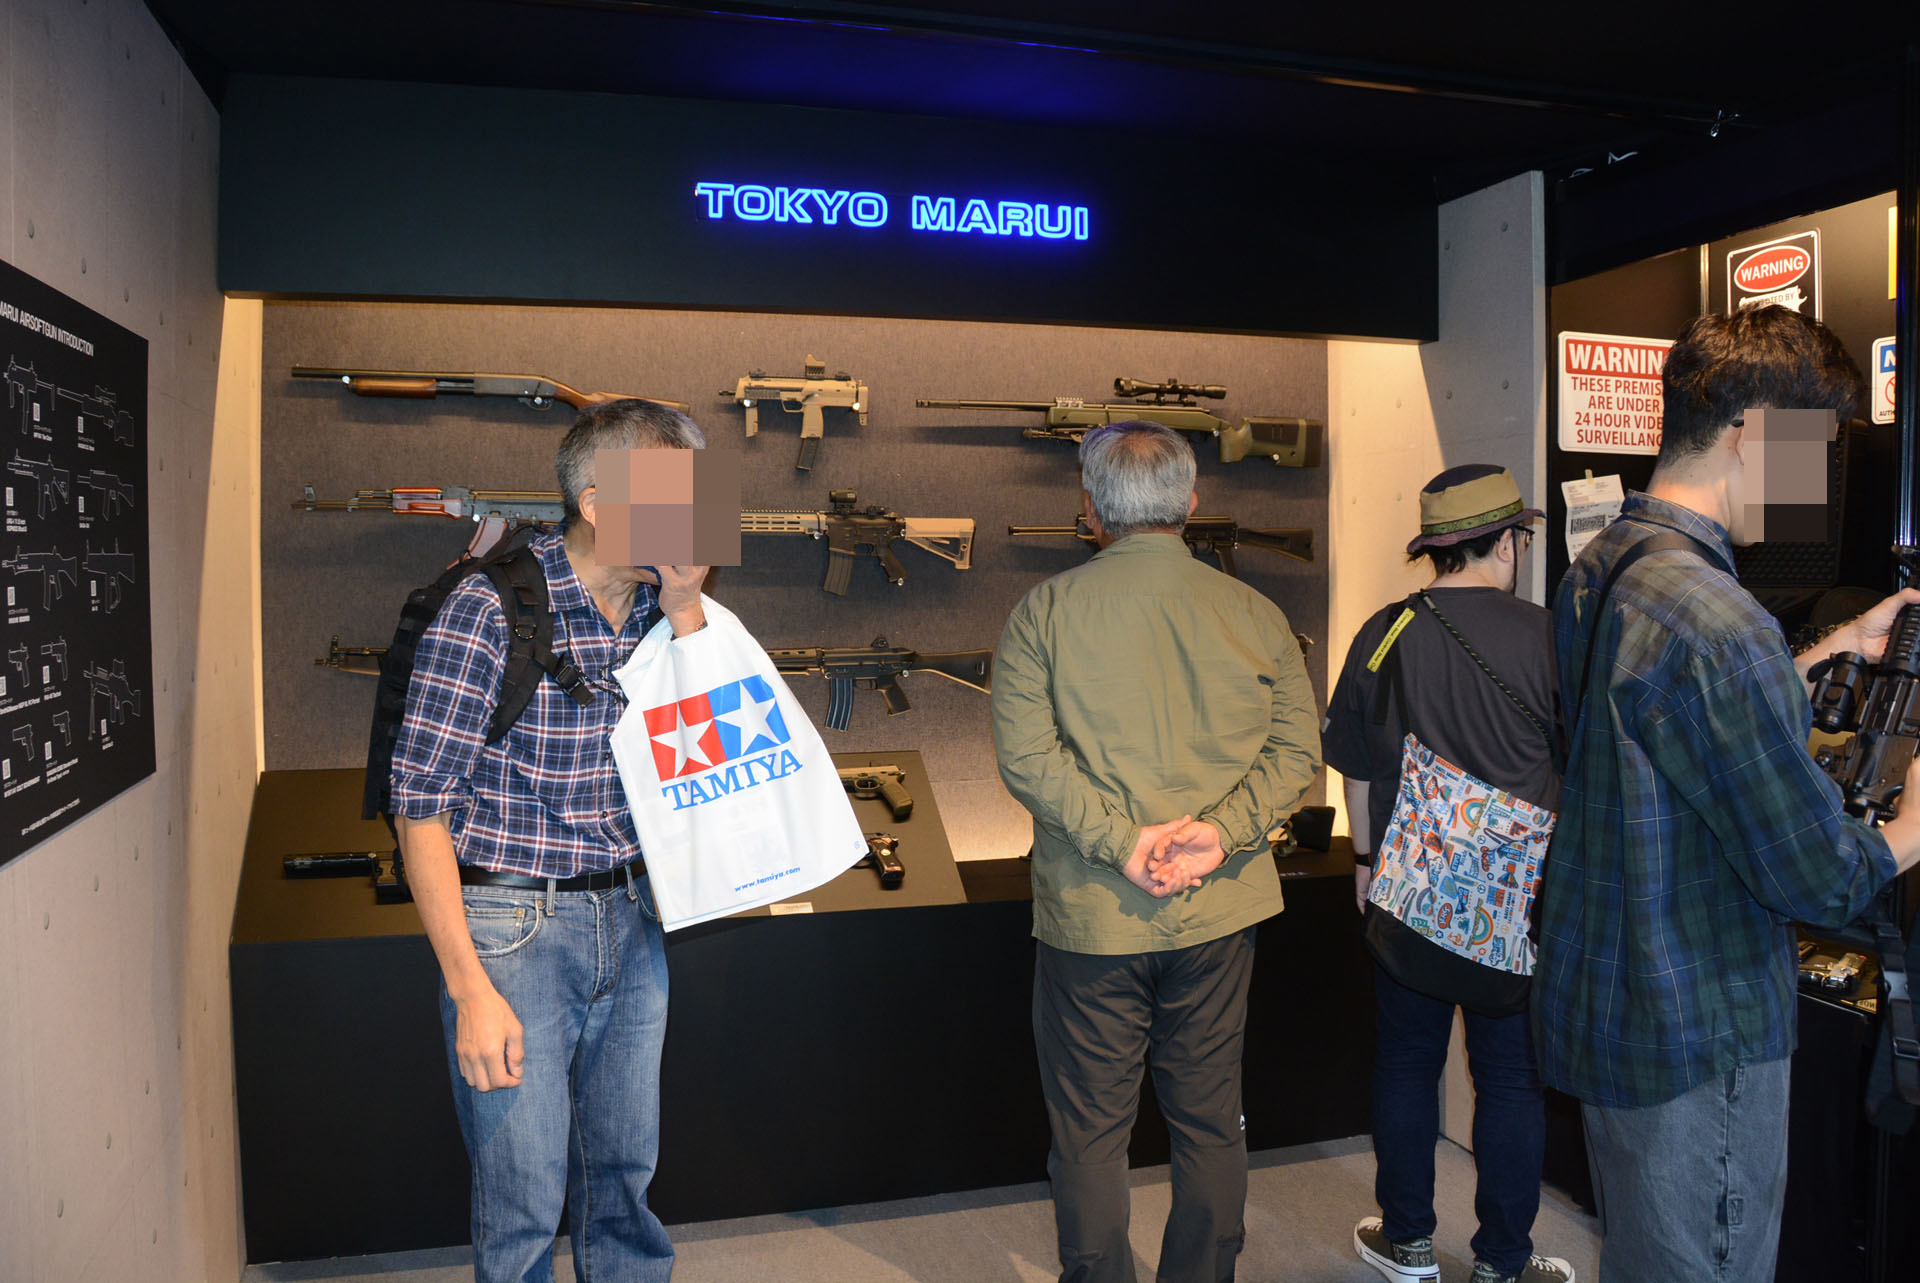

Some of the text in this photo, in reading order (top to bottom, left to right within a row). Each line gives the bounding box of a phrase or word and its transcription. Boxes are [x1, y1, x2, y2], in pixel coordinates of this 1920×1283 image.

[696, 182, 1089, 240] TOKYO MARUI
[1741, 256, 1804, 282] WARNING
[20, 311, 57, 340] AIRSOFTGUN
[58, 328, 94, 357] INTRODUCTION
[1569, 343, 1663, 375] WARNIN
[1571, 376, 1663, 396] THESE PREMIS
[1588, 395, 1660, 413] ARE UNDER
[1575, 411, 1663, 430] 24 HOUR VIDE
[1577, 429, 1662, 447] SURVEILLANC
[661, 749, 804, 811] TAMIYA
[734, 866, 802, 892] www.tamiya.com
[1522, 855, 1537, 895] GROOVY!
